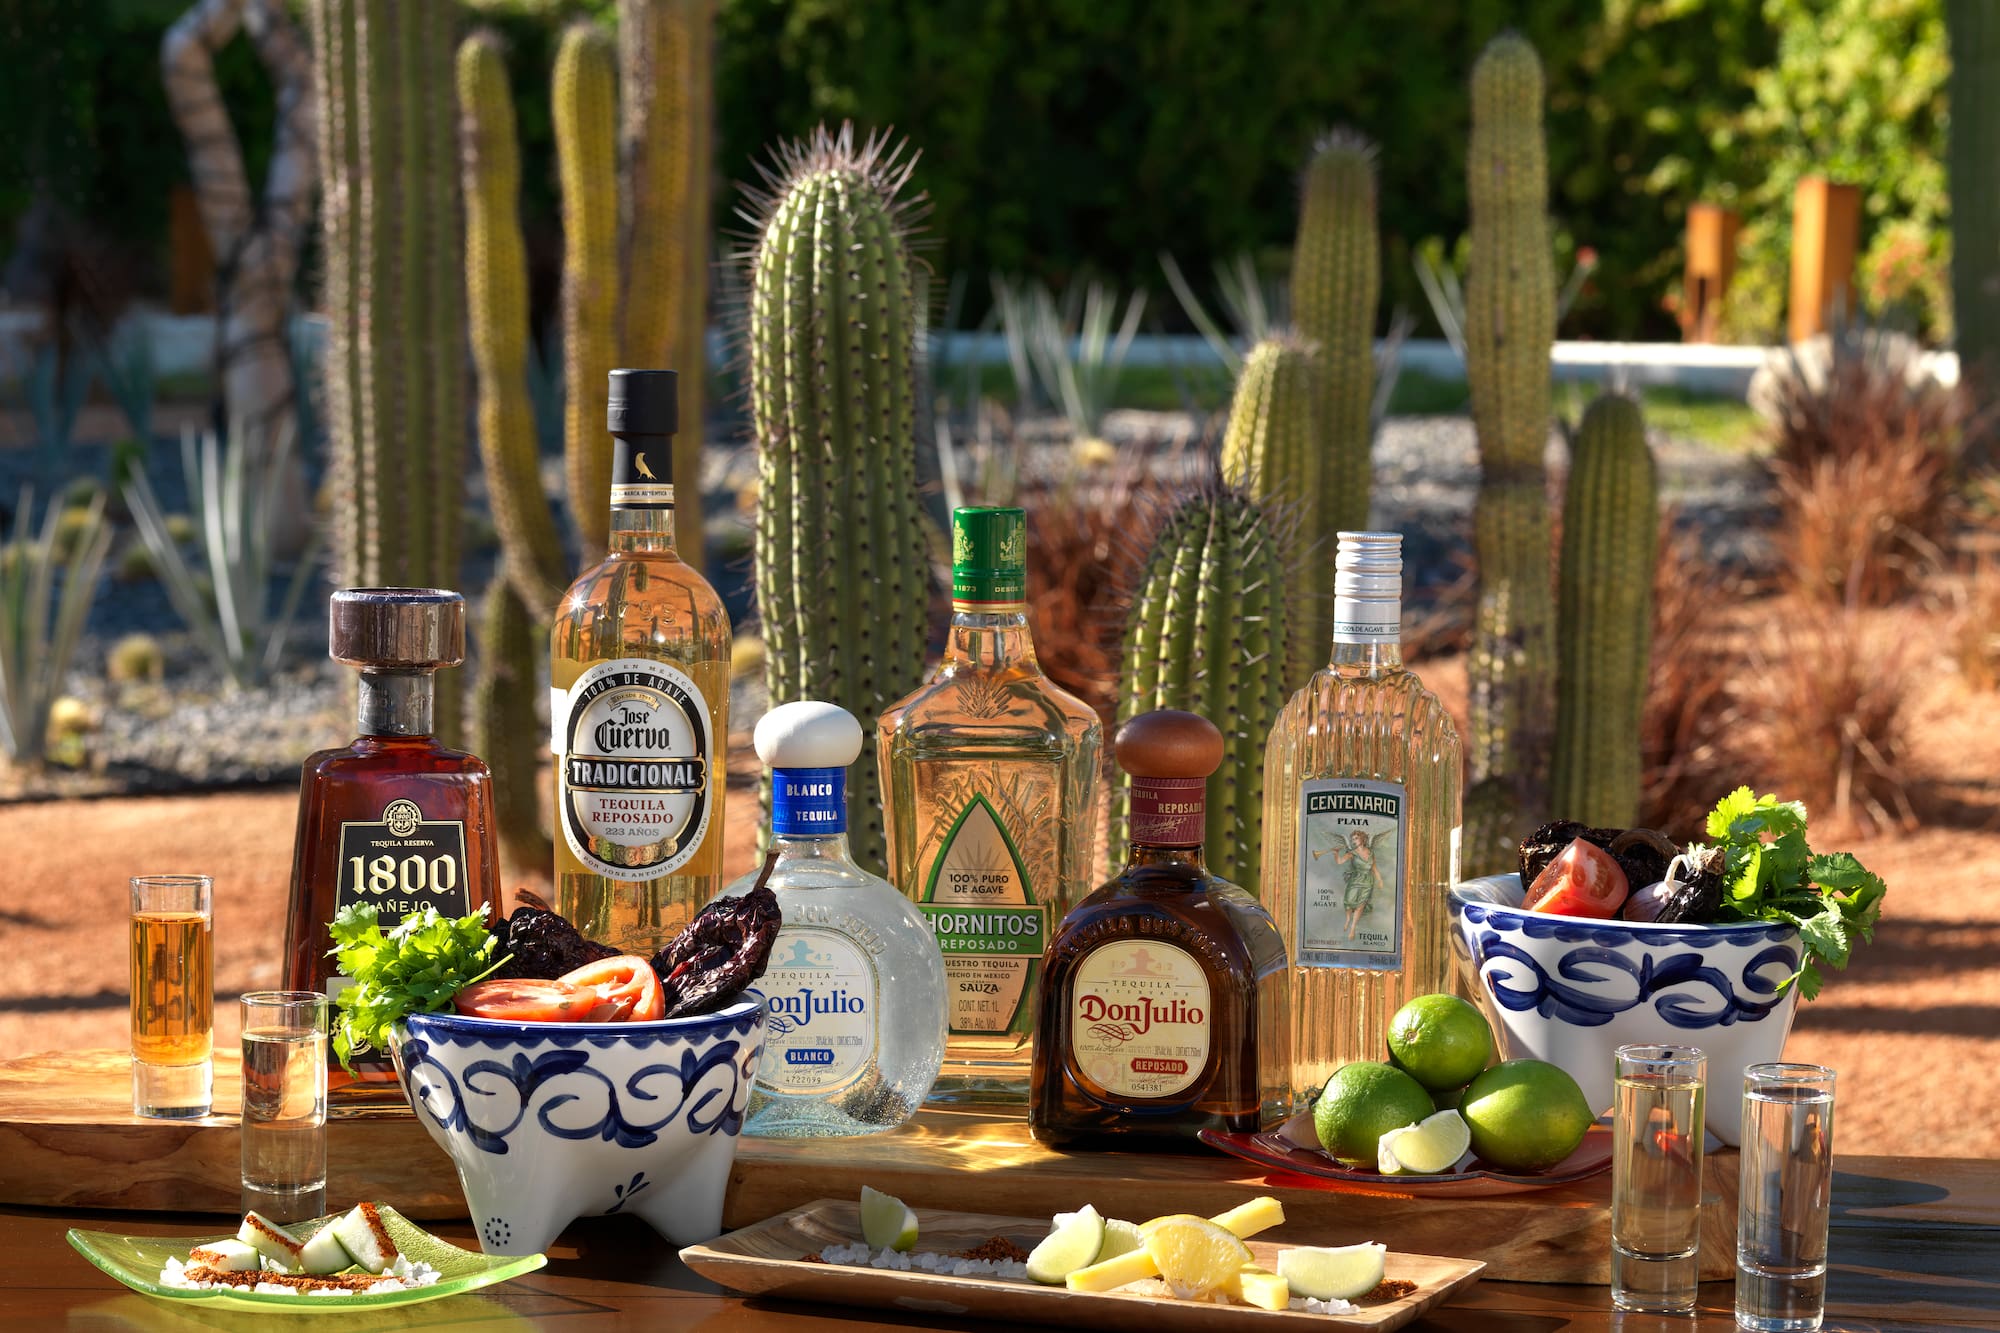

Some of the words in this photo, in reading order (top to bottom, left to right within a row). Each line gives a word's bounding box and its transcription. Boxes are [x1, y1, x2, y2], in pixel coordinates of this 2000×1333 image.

[584, 676, 617, 700] 100%
[624, 673, 640, 685] DE
[647, 675, 689, 705] AGAVE
[619, 707, 650, 727] Jose
[594, 718, 670, 753] Cuervo
[571, 761, 696, 786] TRADICIONAL
[786, 783, 833, 797] BLANCO
[600, 798, 666, 811] TEQUILA
[1310, 794, 1396, 815] CENTENARIO
[591, 811, 674, 824] REPOSADO
[796, 810, 838, 822] TEQUILA
[1337, 817, 1369, 826] PLATA
[605, 827, 625, 836] 223
[627, 826, 660, 837] AÑOS
[370, 840, 402, 848] TEQUILA
[583, 855, 601, 869] POR
[348, 854, 456, 895] 1800
[950, 873, 979, 883] 100%
[982, 874, 1009, 884] PURO
[954, 884, 968, 893] DE
[971, 885, 1004, 894] AGAVE
[375, 899, 432, 913] AÑEJO
[923, 912, 1039, 936] HORNITOS
[1359, 933, 1388, 942] TEQUILA
[940, 938, 1018, 950] REPOSADO
[945, 959, 979, 968] UESTRO
[982, 960, 1020, 969] TEQUILA
[771, 972, 831, 980] TEQUILA
[959, 983, 1000, 994] SAUZA
[1112, 980, 1171, 989] TEQUILA
[790, 1051, 830, 1062] BLANCO
[1135, 1060, 1184, 1073] REPOSADO
